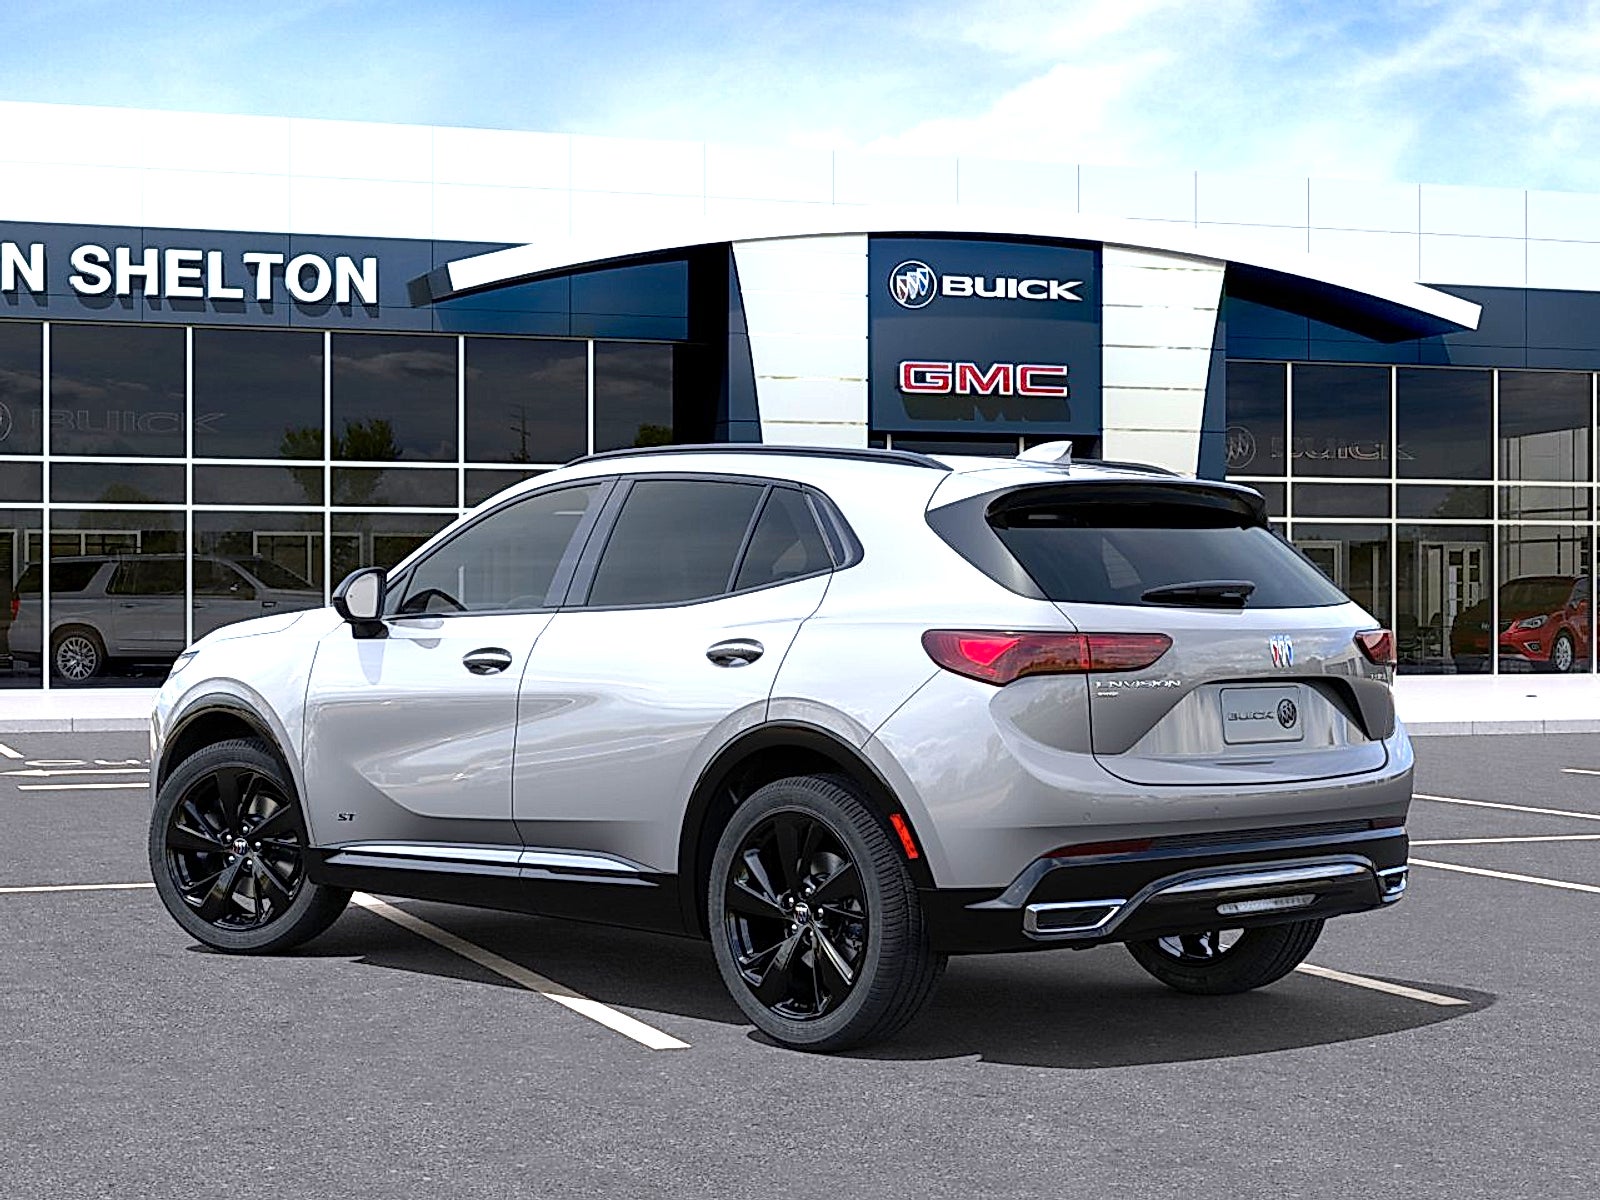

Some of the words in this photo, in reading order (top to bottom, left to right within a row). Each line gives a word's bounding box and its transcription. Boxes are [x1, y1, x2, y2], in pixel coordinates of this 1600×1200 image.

[69, 244, 377, 304] SHELTON
[942, 275, 1085, 302] BUICK
[899, 361, 1068, 398] GMC
[1227, 711, 1275, 721] BUICK
[337, 812, 357, 822] ST
